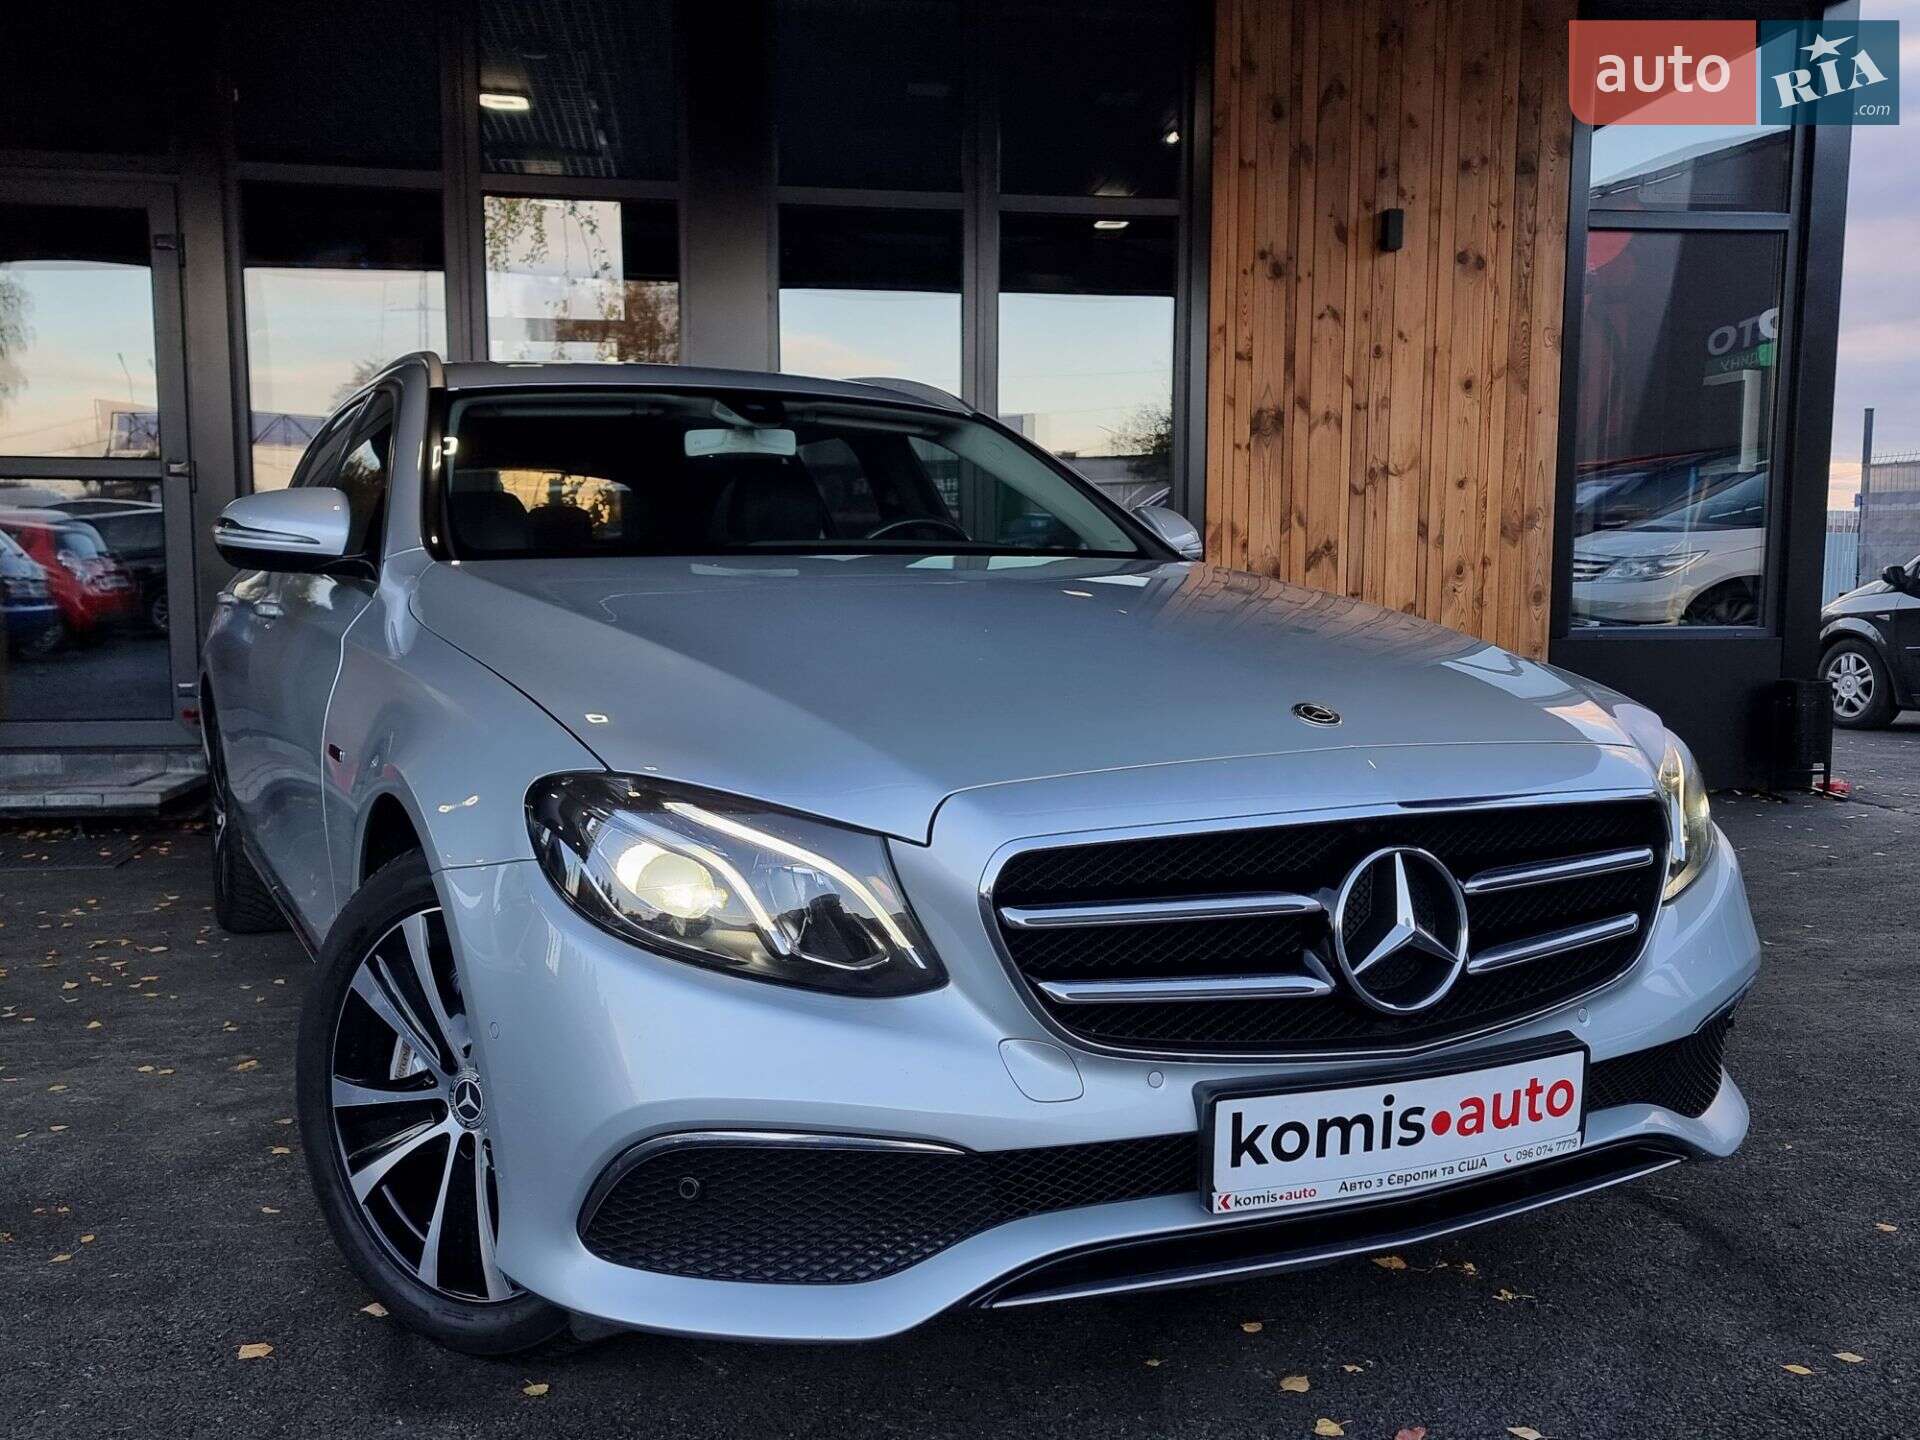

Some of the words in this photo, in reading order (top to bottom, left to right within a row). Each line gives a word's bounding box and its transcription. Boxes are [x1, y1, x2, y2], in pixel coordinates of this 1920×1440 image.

[1515, 1150, 1534, 1162] 096
[1338, 1180, 1373, 1194] Авто
[1376, 1178, 1383, 1187] з
[1387, 1167, 1438, 1186] Європи
[1440, 1164, 1455, 1177] та
[1457, 1156, 1488, 1173] США
